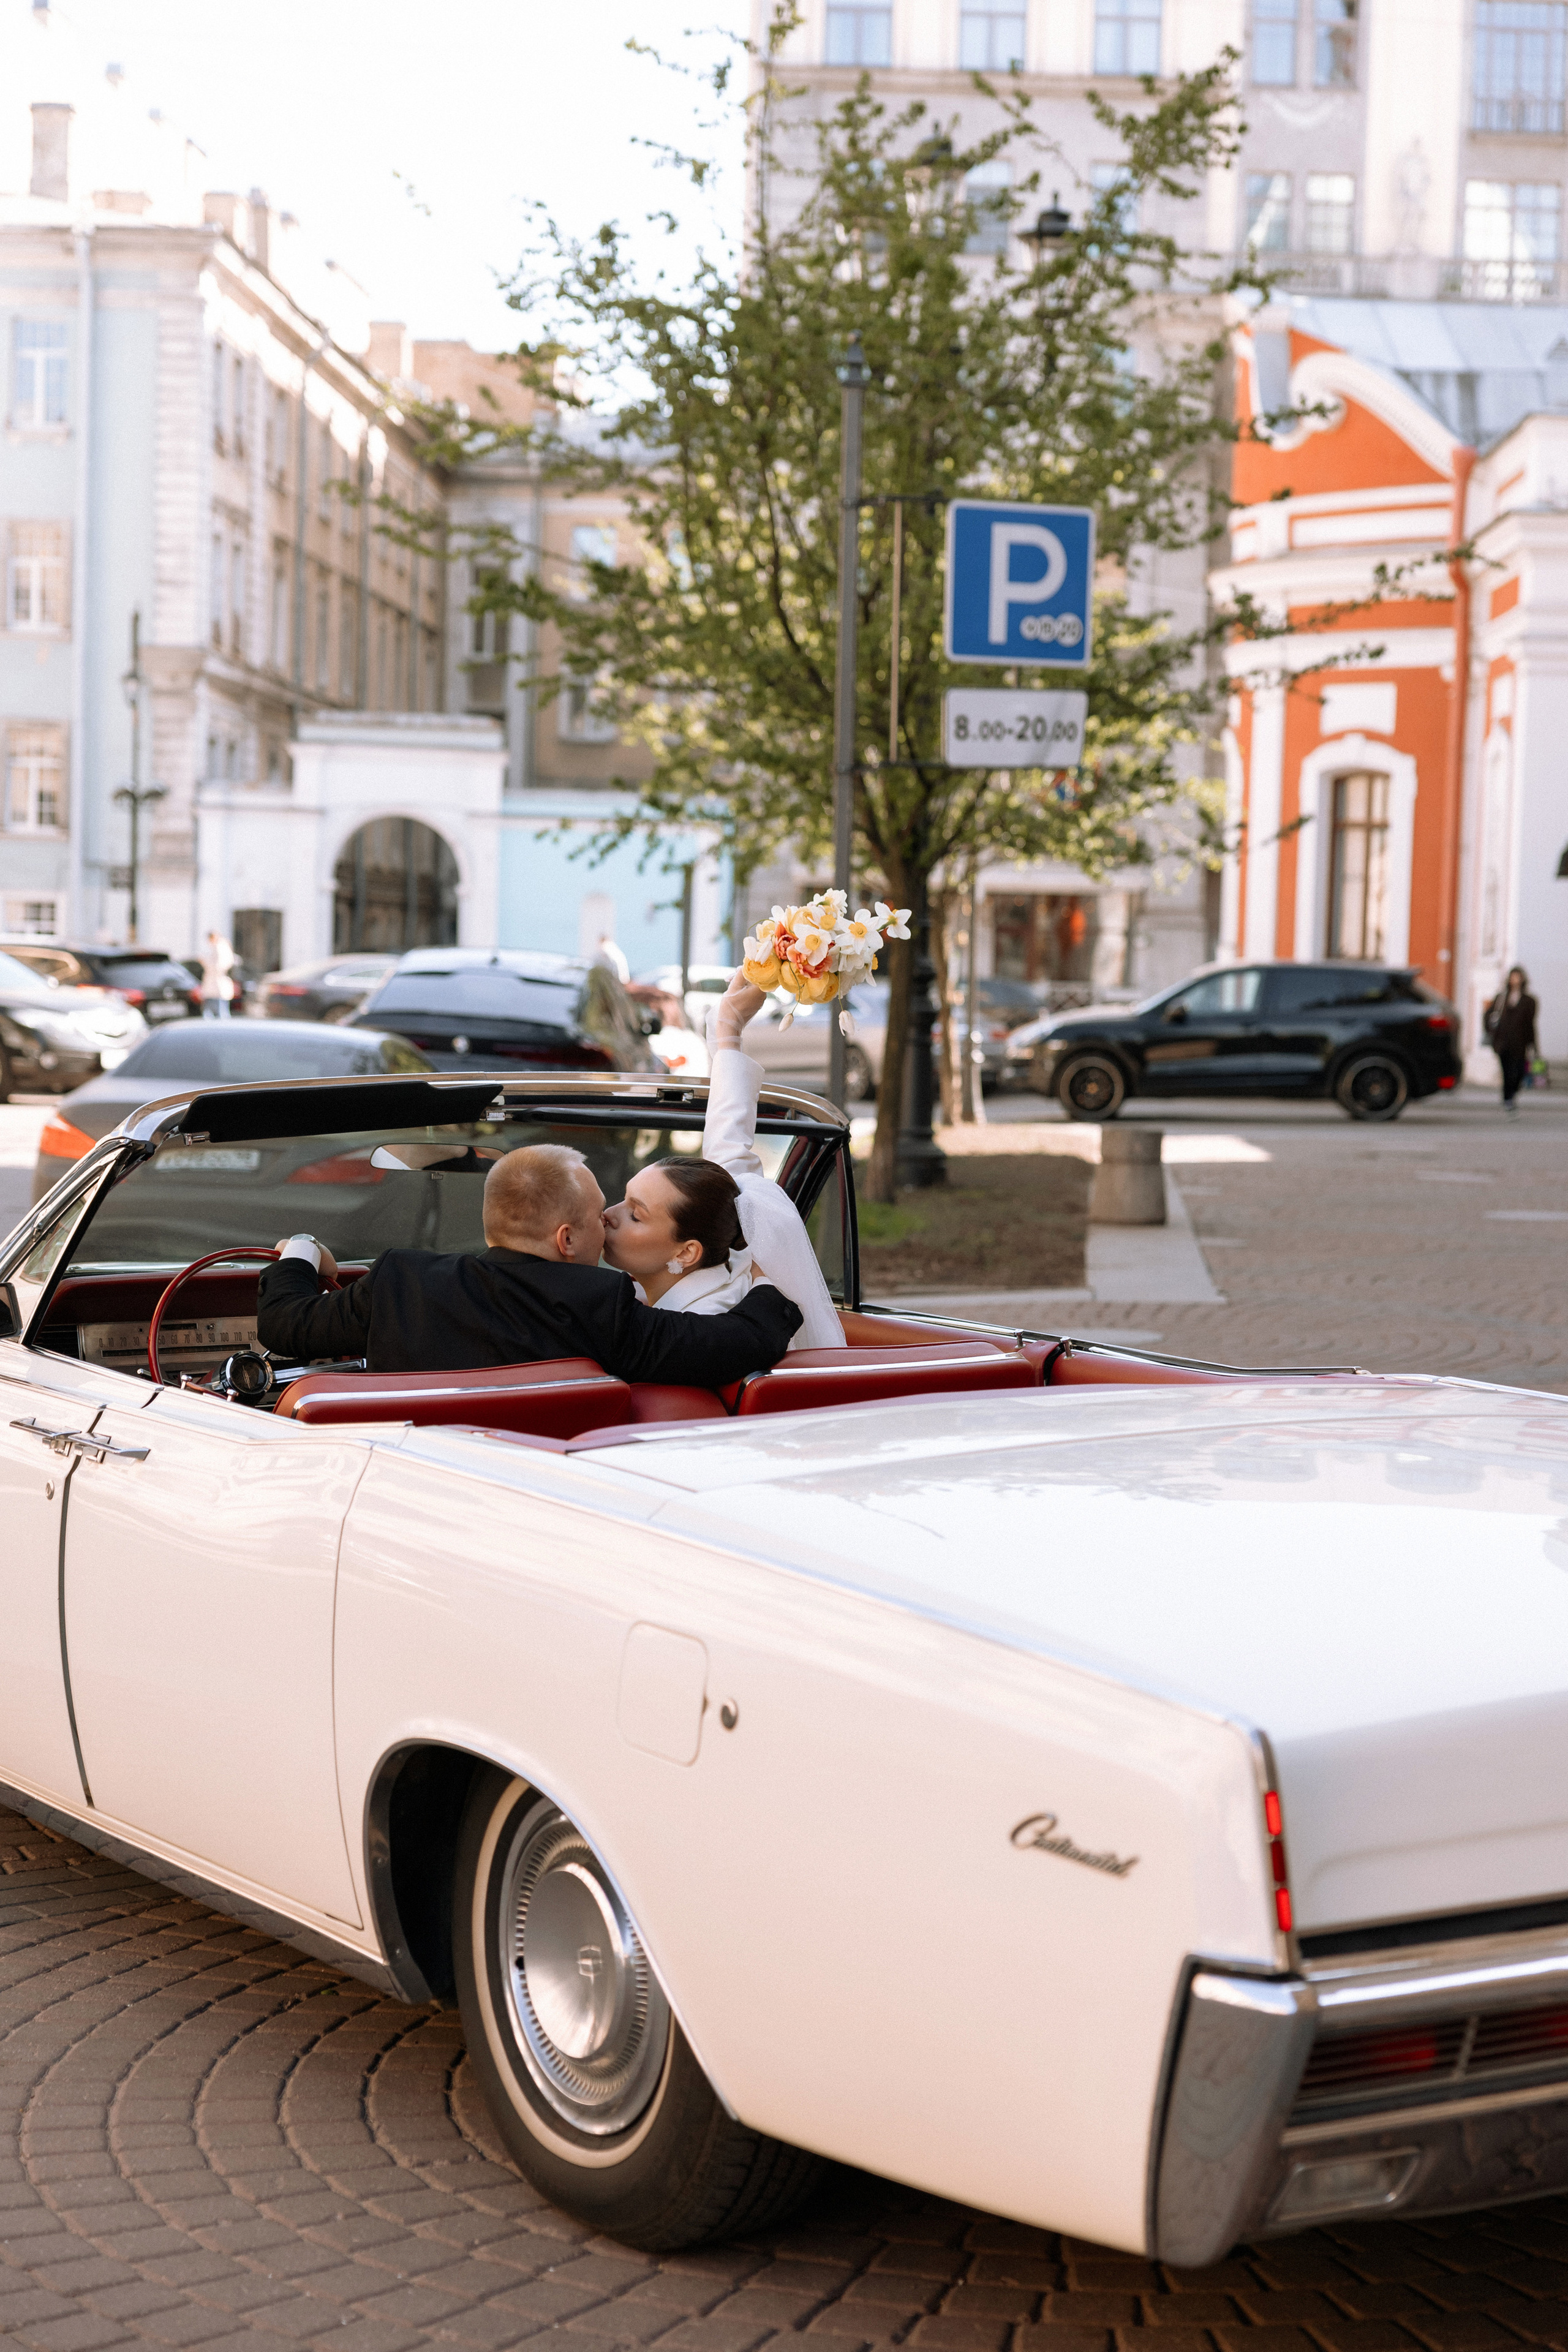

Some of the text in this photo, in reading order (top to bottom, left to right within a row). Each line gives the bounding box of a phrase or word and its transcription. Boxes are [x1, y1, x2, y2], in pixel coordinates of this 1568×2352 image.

[987, 521, 1068, 646] P
[99, 1338, 103, 1348] 0
[108, 1337, 114, 1348] 10
[120, 1336, 127, 1347] 20
[133, 1336, 140, 1346] 30
[158, 1335, 165, 1345] 50
[170, 1334, 178, 1344] 60
[184, 1334, 190, 1344] 70
[196, 1333, 203, 1343] 80
[208, 1333, 215, 1343] 90
[220, 1332, 229, 1342] 100
[233, 1332, 242, 1341] 110
[247, 1331, 257, 1341] 120
